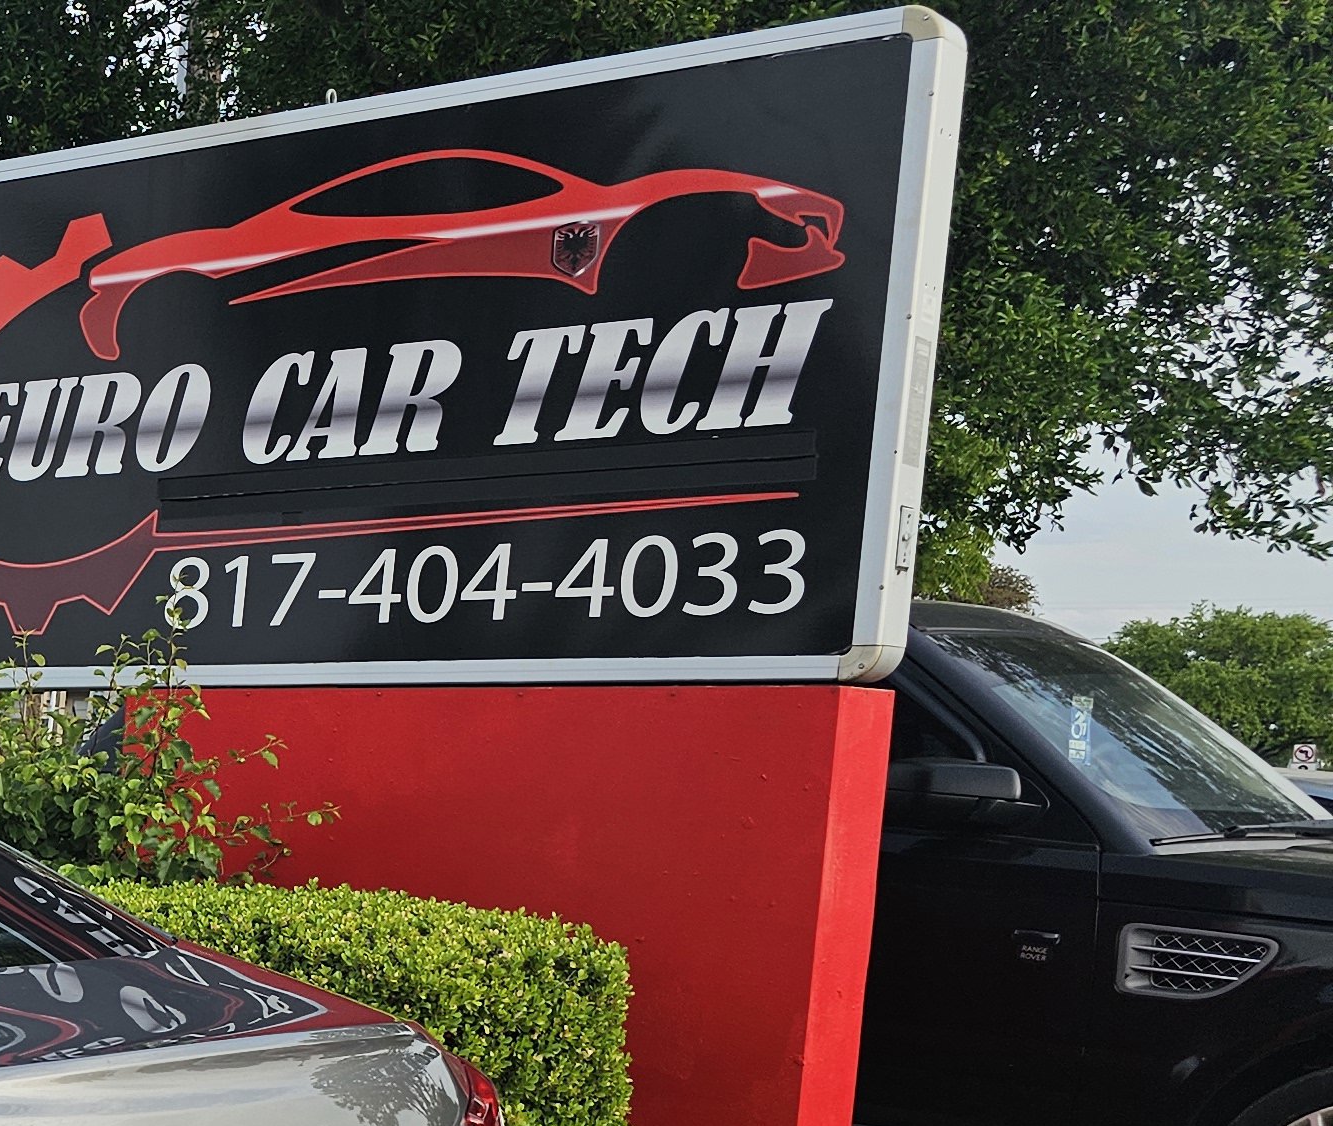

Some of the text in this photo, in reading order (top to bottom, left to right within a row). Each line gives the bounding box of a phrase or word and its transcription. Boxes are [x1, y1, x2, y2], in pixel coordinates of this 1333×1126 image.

[241, 338, 462, 465] CAR
[493, 298, 833, 446] TECH
[164, 529, 806, 630] 817-404-4033
[1020, 951, 1047, 961] ROVER
[1021, 944, 1048, 954] RANGE
